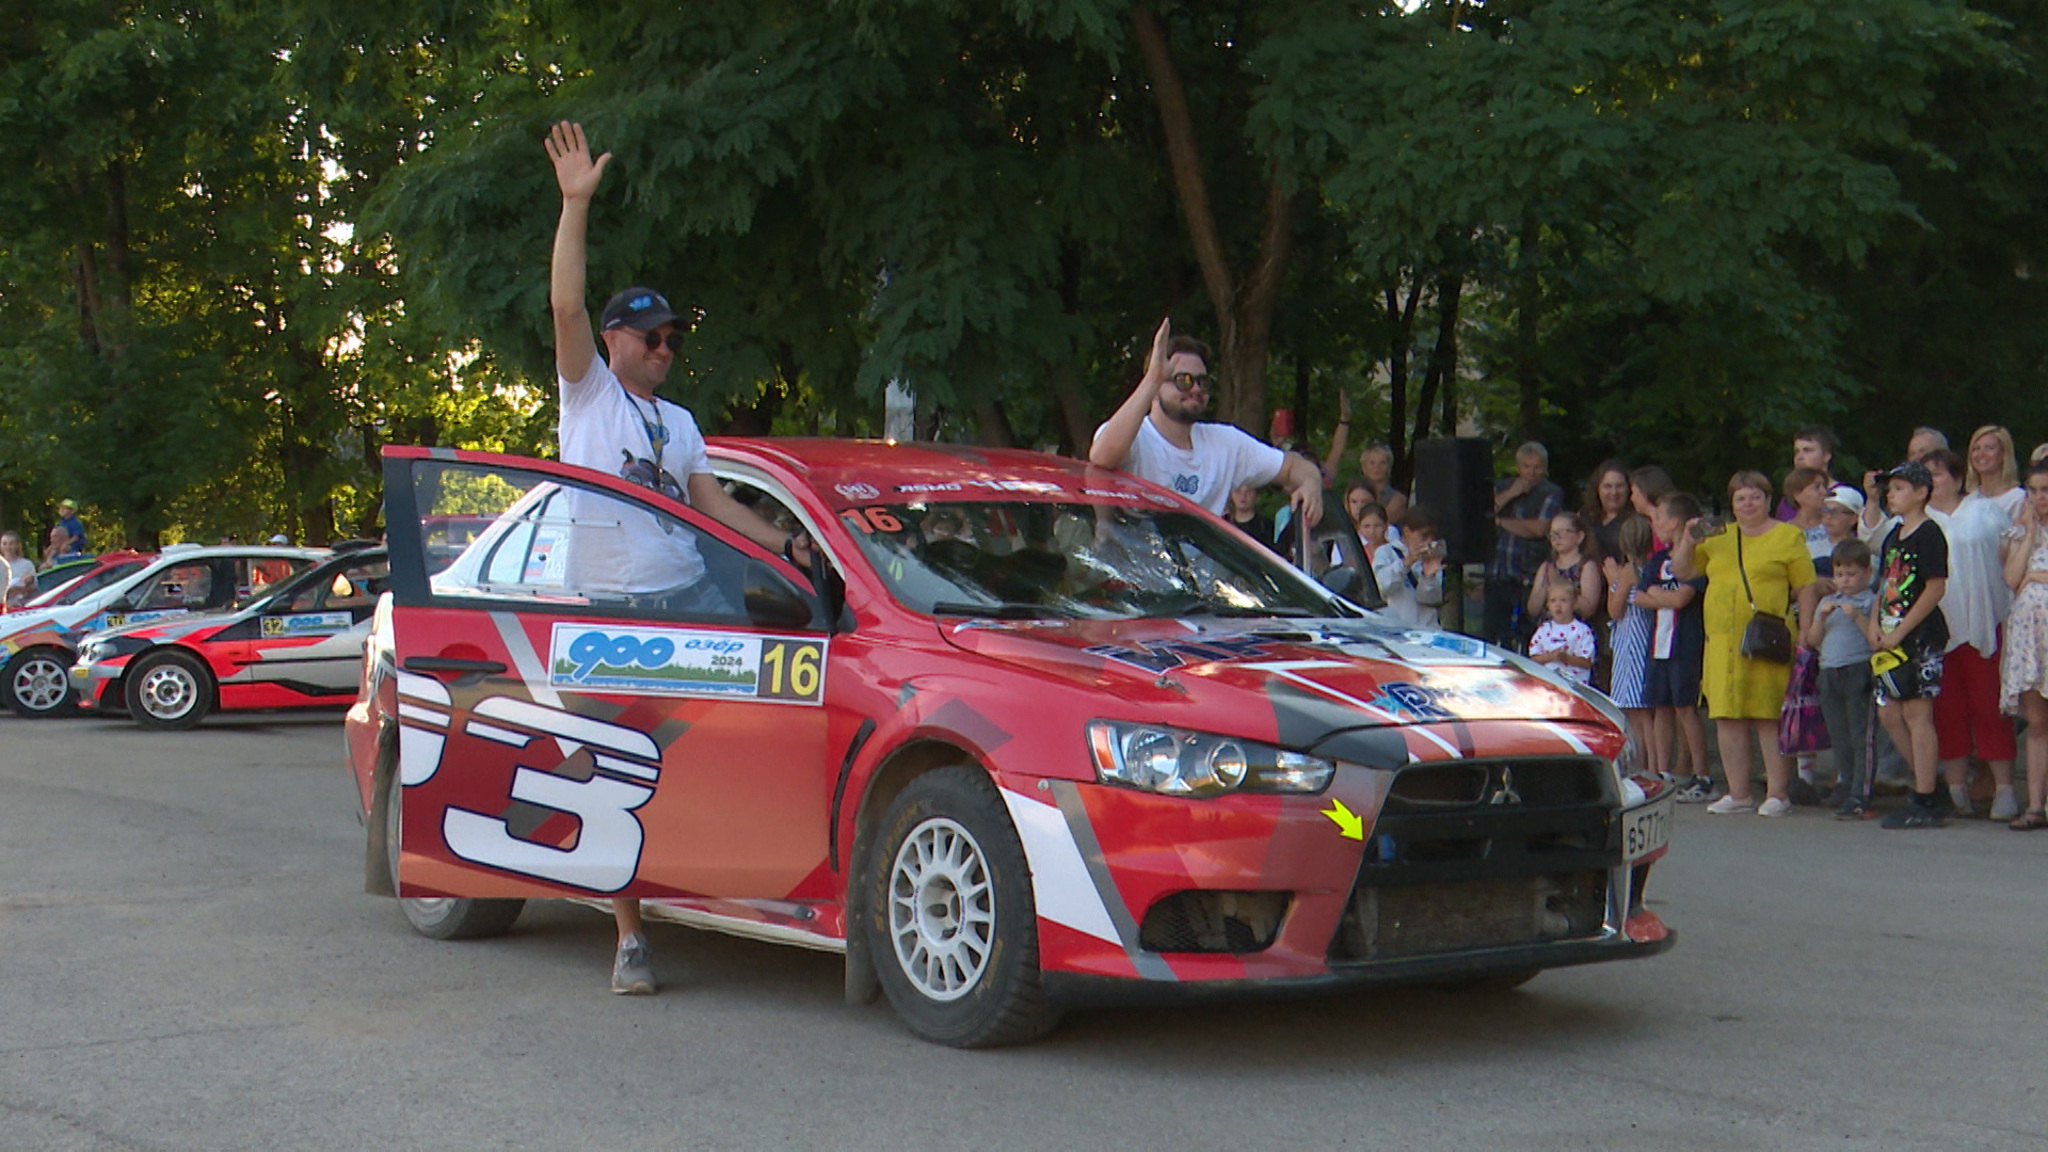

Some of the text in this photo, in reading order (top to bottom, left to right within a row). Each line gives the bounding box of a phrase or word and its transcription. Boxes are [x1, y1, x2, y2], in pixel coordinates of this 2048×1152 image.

[840, 506, 903, 534] 16
[263, 618, 283, 635] 32
[569, 631, 675, 682] 900
[711, 654, 743, 667] 2024
[763, 643, 820, 696] 16
